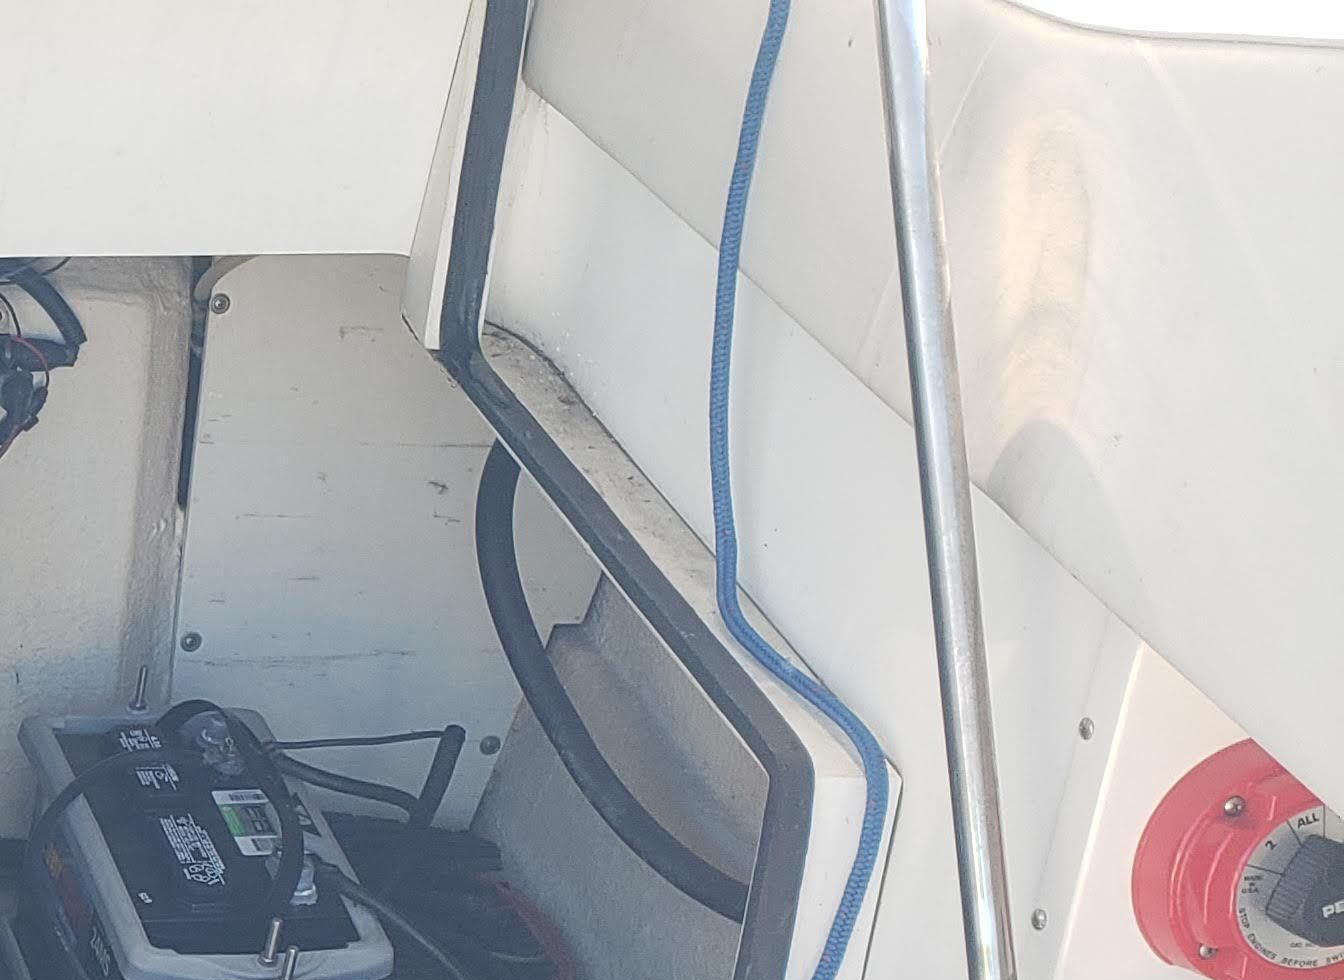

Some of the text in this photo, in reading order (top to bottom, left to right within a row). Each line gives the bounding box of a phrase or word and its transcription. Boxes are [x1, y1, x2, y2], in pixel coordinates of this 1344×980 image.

[1297, 812, 1320, 829] ALL
[1264, 840, 1277, 851] 2
[1238, 907, 1251, 929] STOP
[1247, 932, 1278, 961] ENGINES
[1281, 957, 1319, 968] BEFORE
